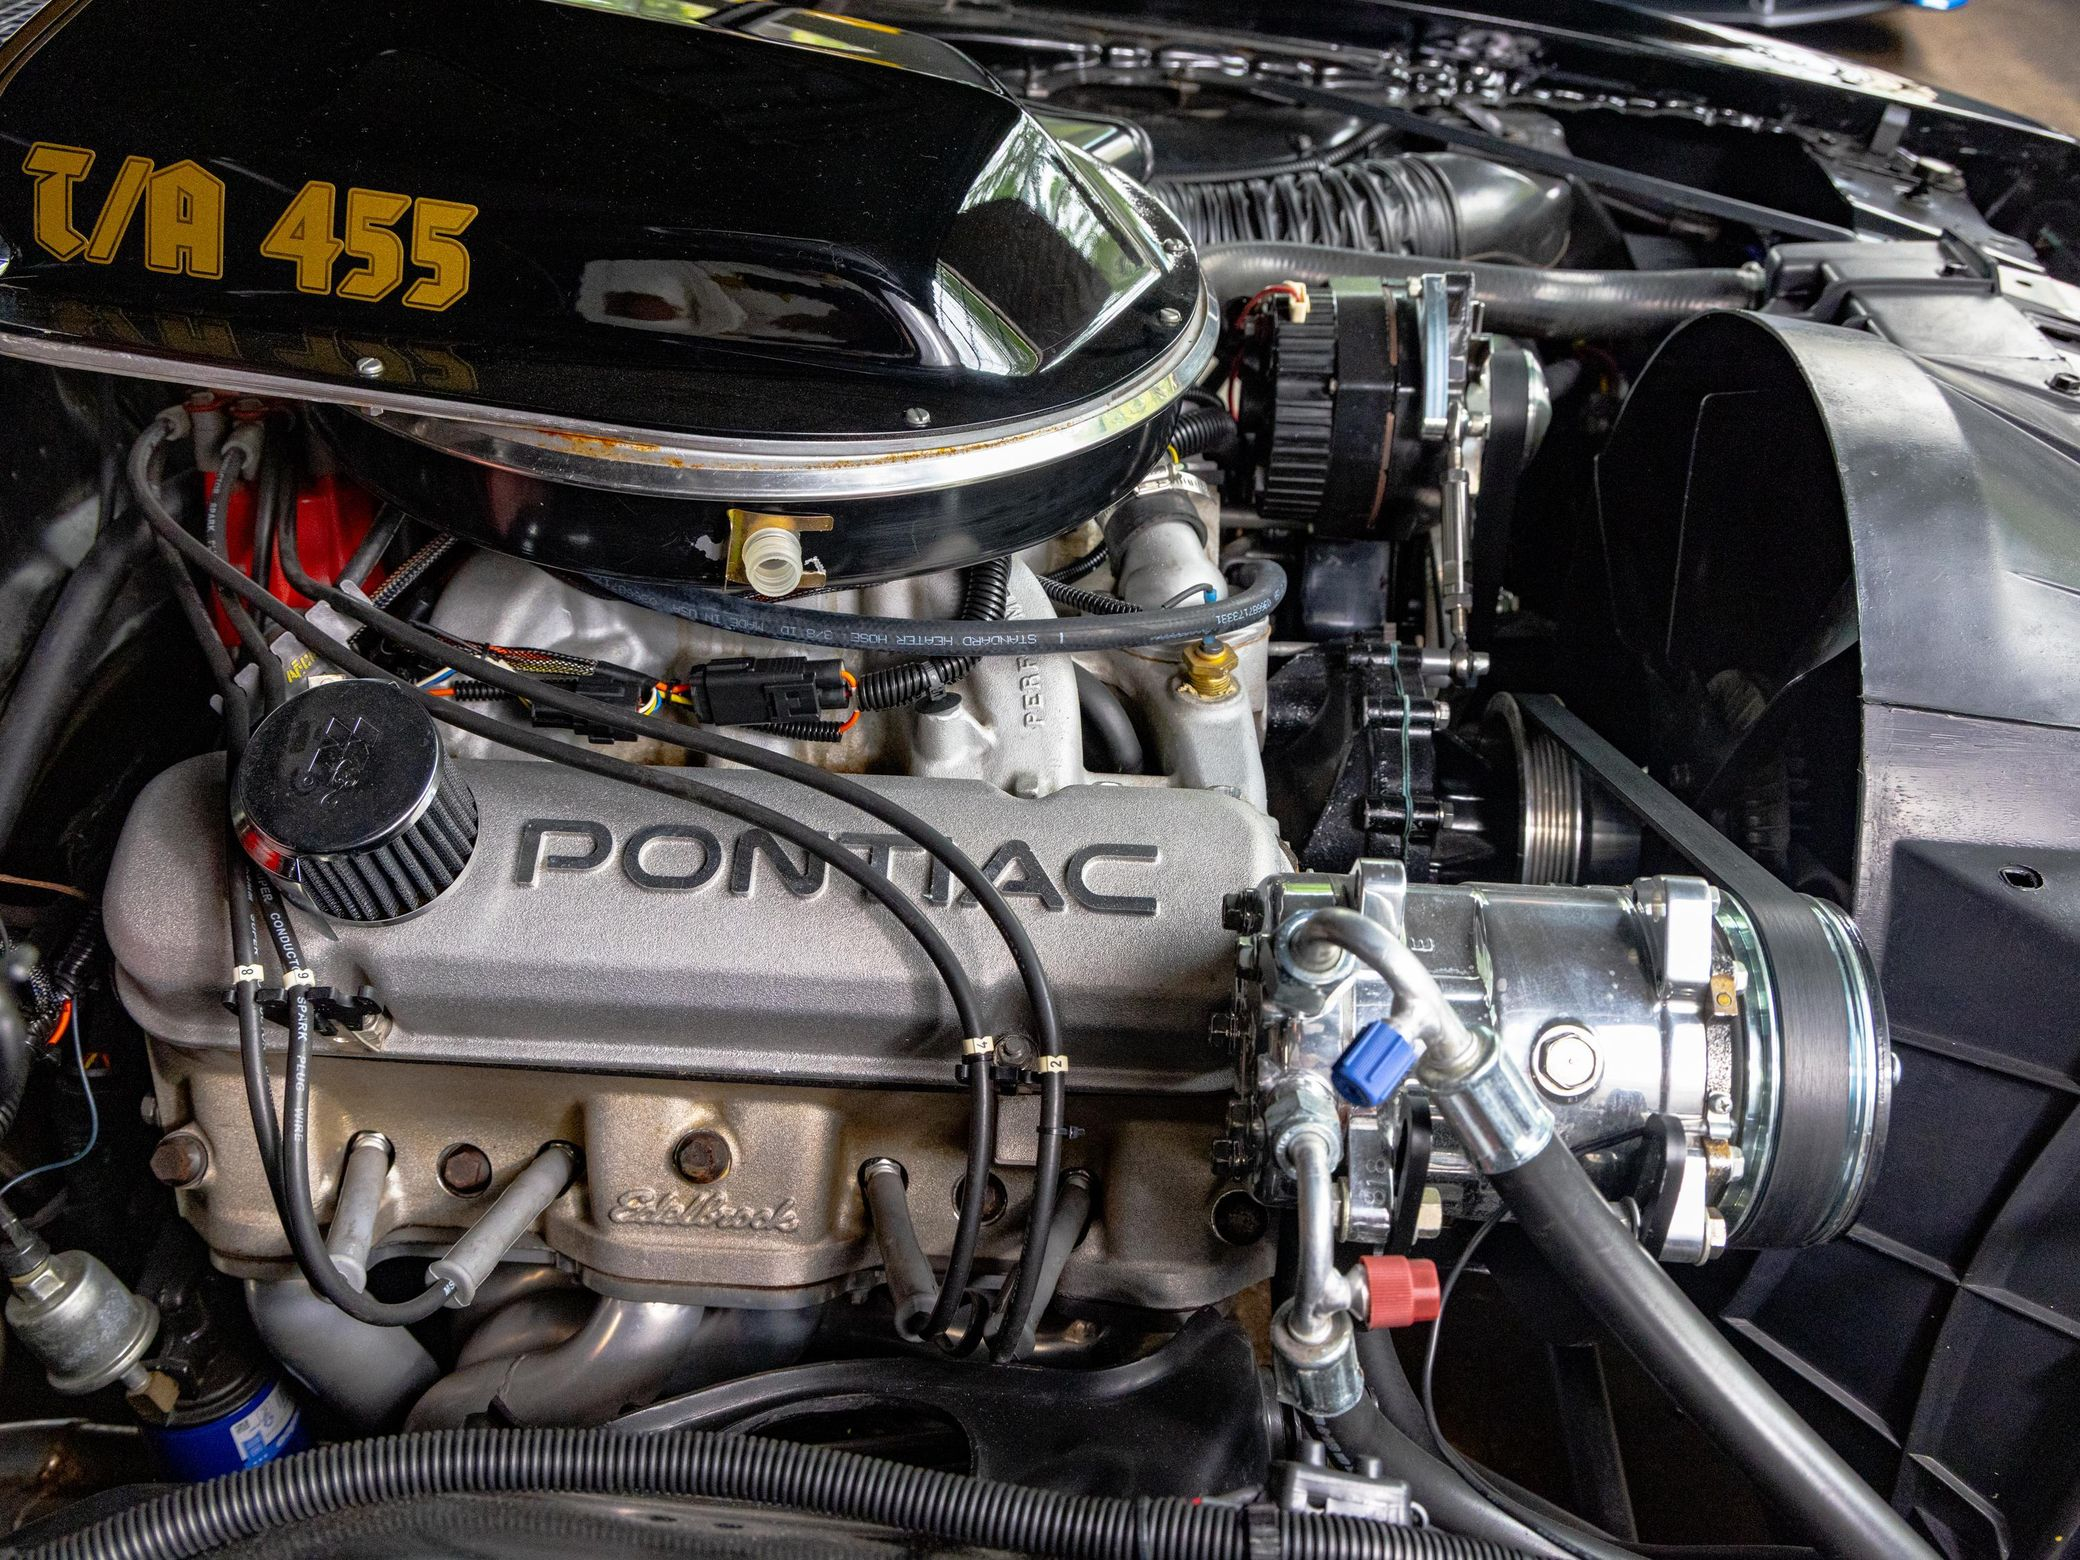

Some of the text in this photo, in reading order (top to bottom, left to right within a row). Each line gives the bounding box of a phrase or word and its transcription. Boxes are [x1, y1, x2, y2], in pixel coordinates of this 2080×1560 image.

[22, 141, 479, 312] T/A 455
[670, 604, 698, 619] USA
[704, 611, 721, 624] IN
[729, 616, 764, 632] MADE
[780, 625, 797, 636] ID
[806, 628, 833, 640] 3/8
[850, 632, 888, 644] HOSE
[896, 634, 953, 646] HEATER
[962, 633, 1037, 646] STANDARD
[514, 817, 1161, 915] PONTIAC
[241, 968, 254, 976] 8
[296, 996, 308, 1041] SPARK
[976, 1040, 988, 1049] 4
[1049, 1060, 1062, 1068] 2
[295, 1055, 307, 1092] PLUG
[294, 1107, 304, 1142] WIRE
[608, 1188, 800, 1233] Edelbrock
